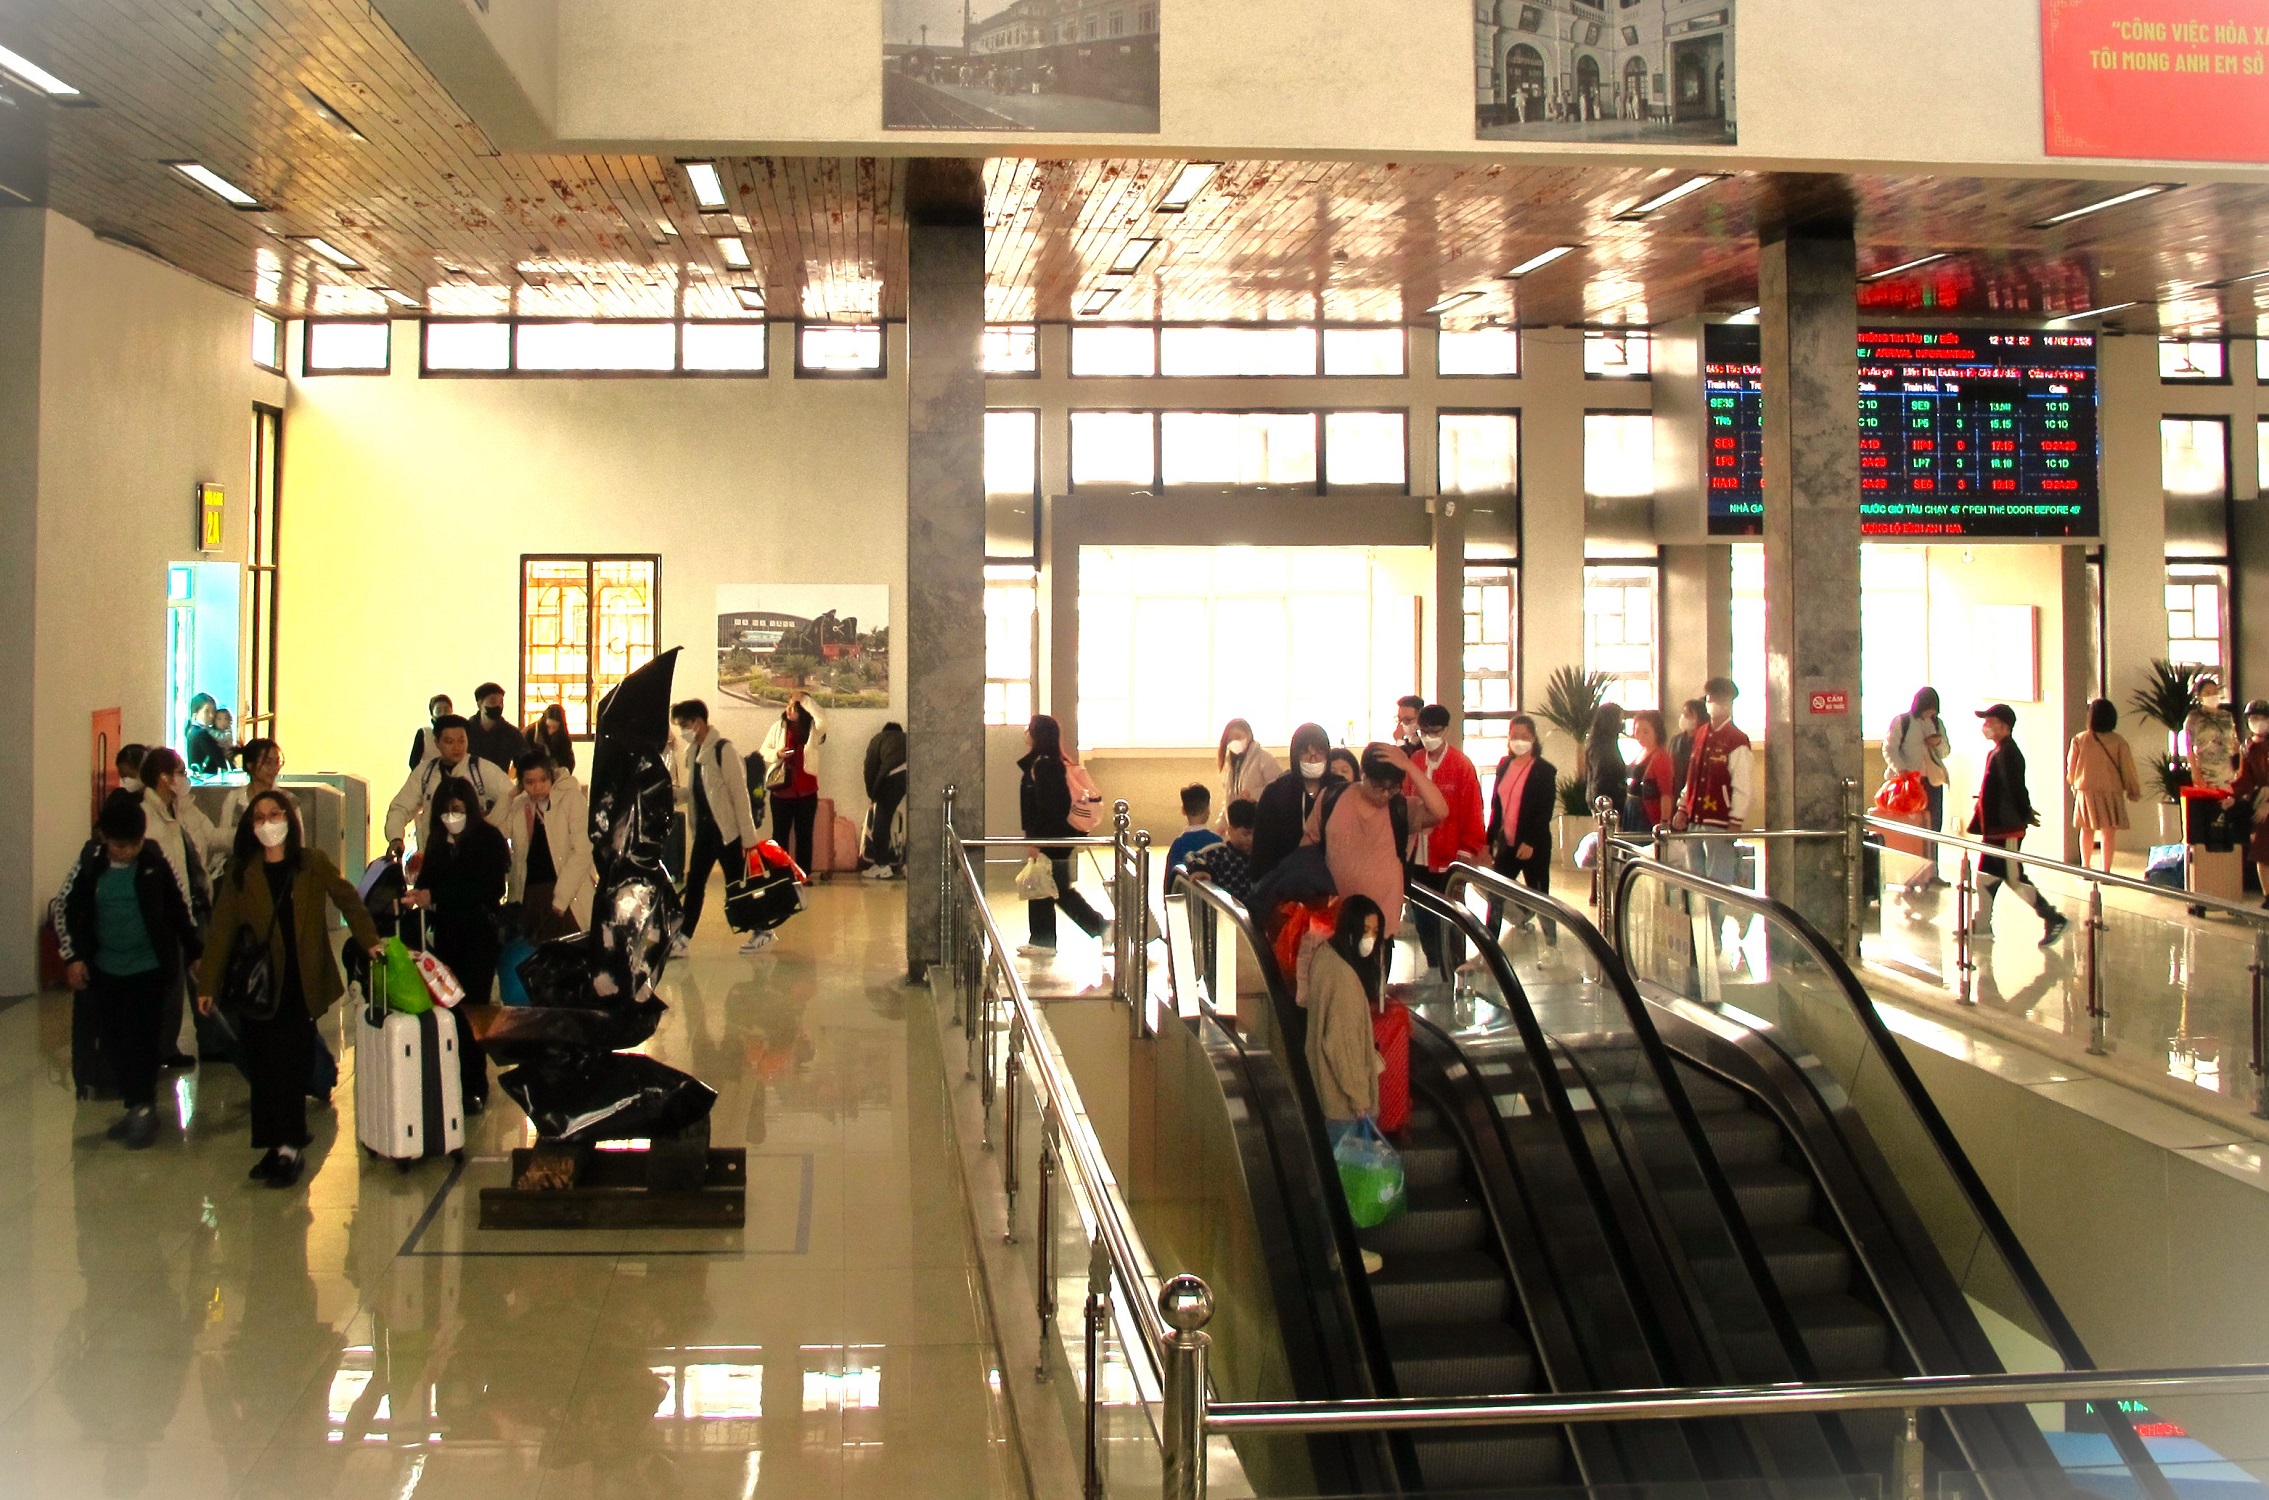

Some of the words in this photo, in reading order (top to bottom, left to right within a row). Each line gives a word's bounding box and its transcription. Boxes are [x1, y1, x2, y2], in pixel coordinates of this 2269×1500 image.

[2171, 19, 2210, 49] VIỆC
[2214, 20, 2249, 45] HỎA
[2090, 46, 2117, 70] TÔI
[2122, 51, 2170, 71] MONG
[2175, 53, 2210, 73] ANH
[2215, 55, 2238, 74] EM
[1956, 419, 1963, 428] 3
[1957, 458, 1963, 468] 3
[1730, 502, 1749, 513] NHÀ
[1859, 503, 1886, 514] RƯỚC
[1905, 503, 1923, 514] TÀU
[1987, 505, 2005, 514] THE
